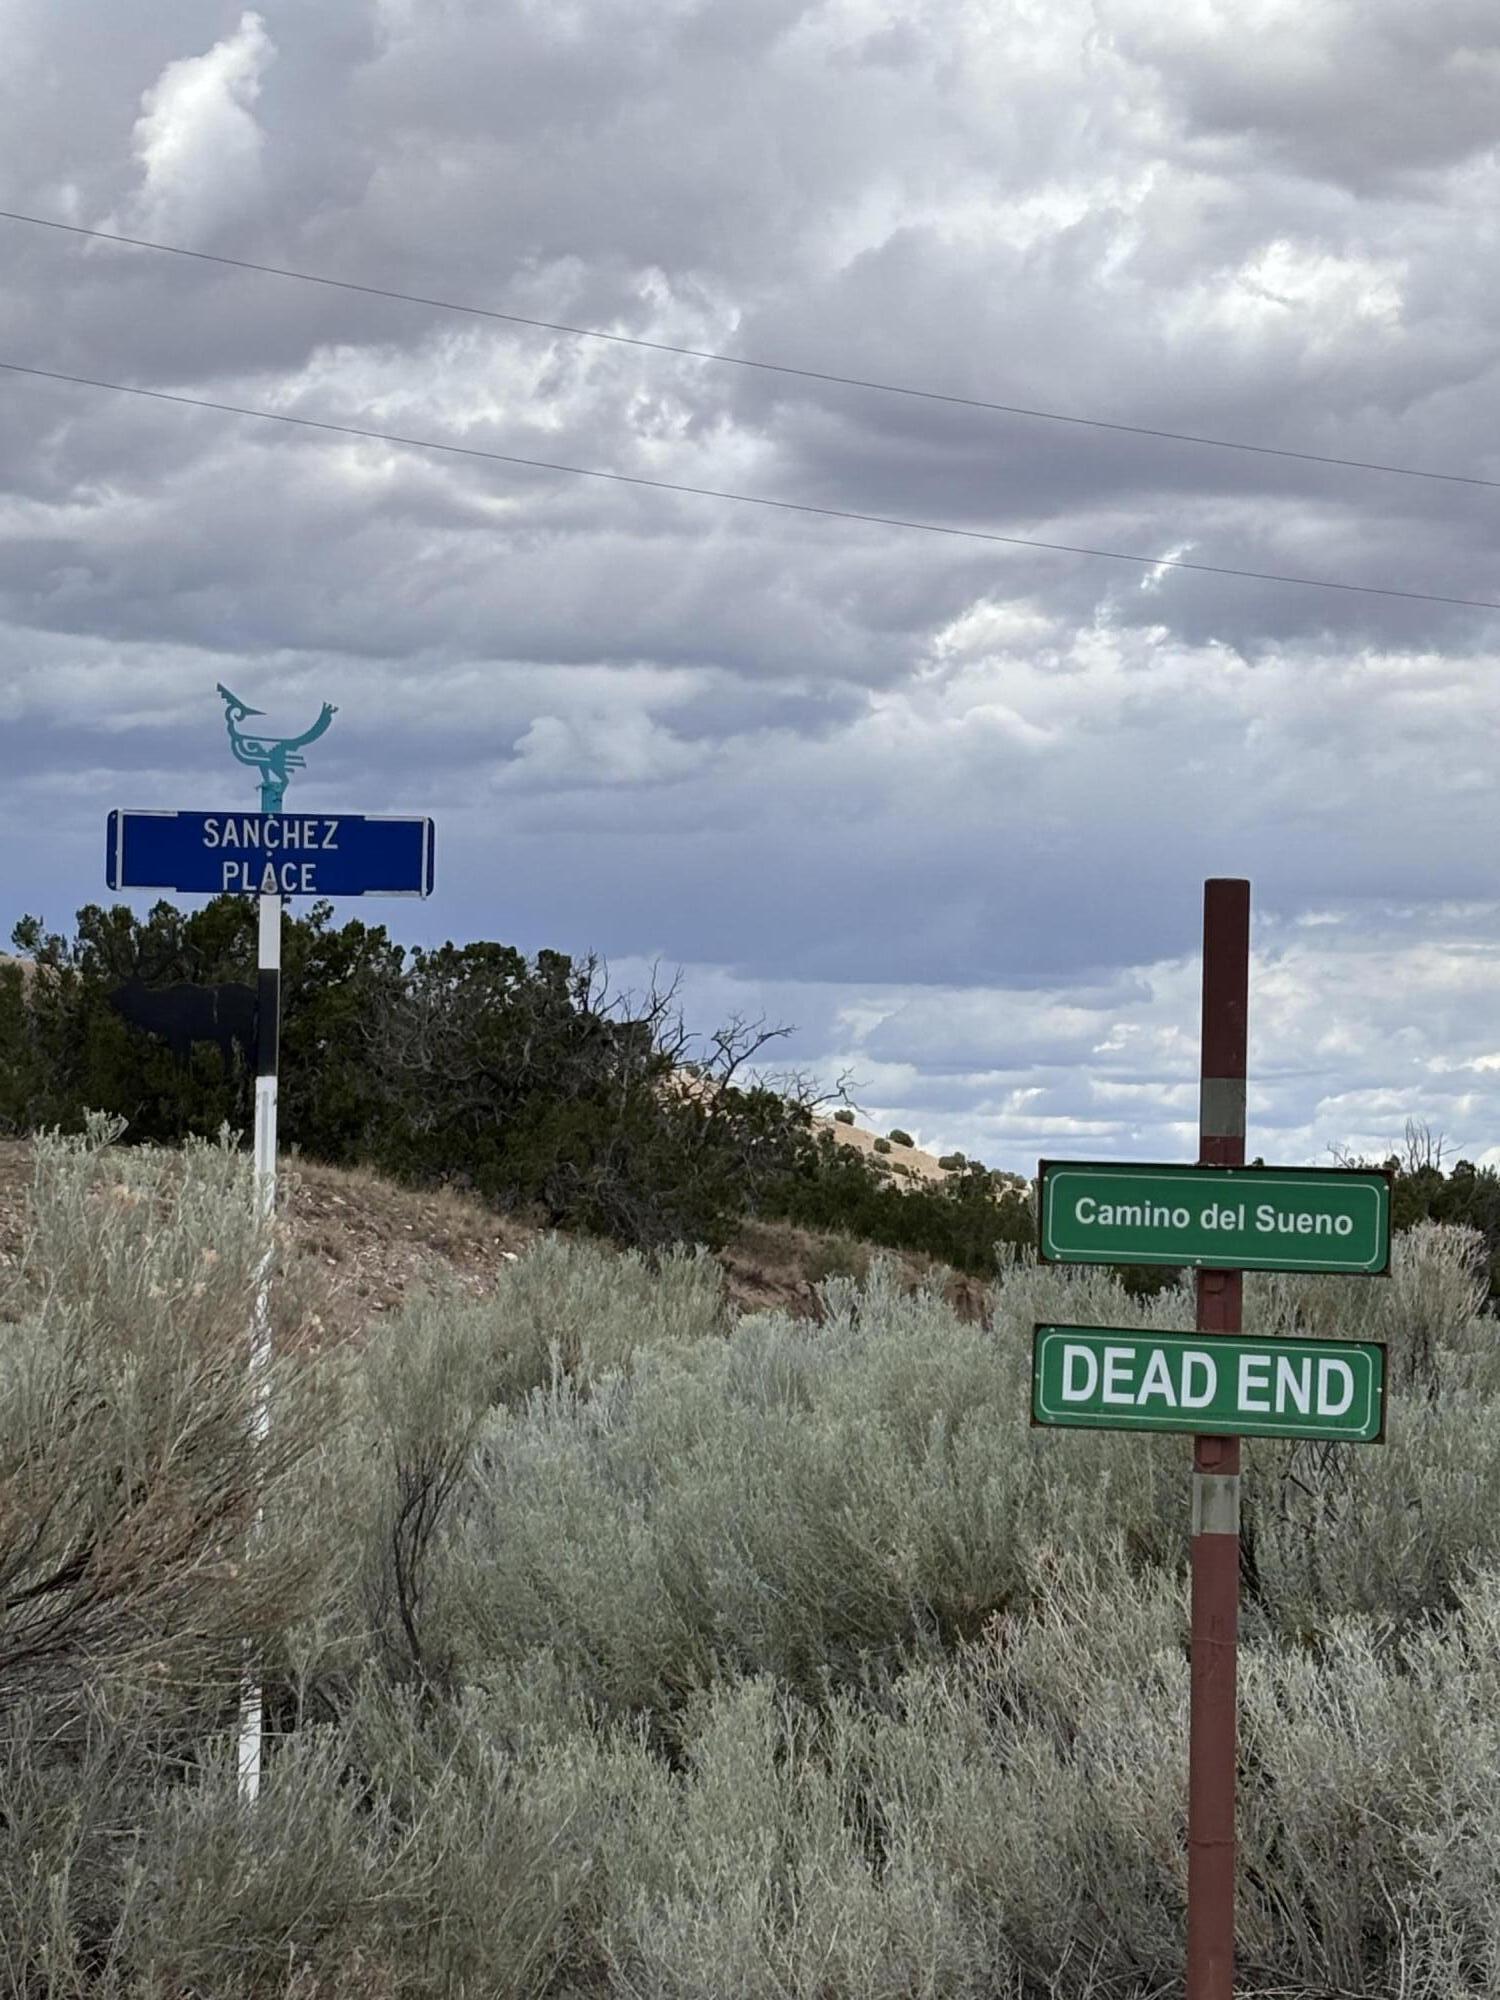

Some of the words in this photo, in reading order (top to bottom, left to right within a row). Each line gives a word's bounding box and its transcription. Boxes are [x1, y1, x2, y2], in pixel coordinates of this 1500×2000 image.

[203, 819, 339, 850] SANCHEZ
[222, 861, 317, 892] PLACE
[1075, 1197, 1191, 1229] Camino
[1200, 1203, 1246, 1231] del
[1255, 1204, 1353, 1236] Sueno
[1061, 1344, 1218, 1409] DEAD
[1237, 1353, 1355, 1417] END
